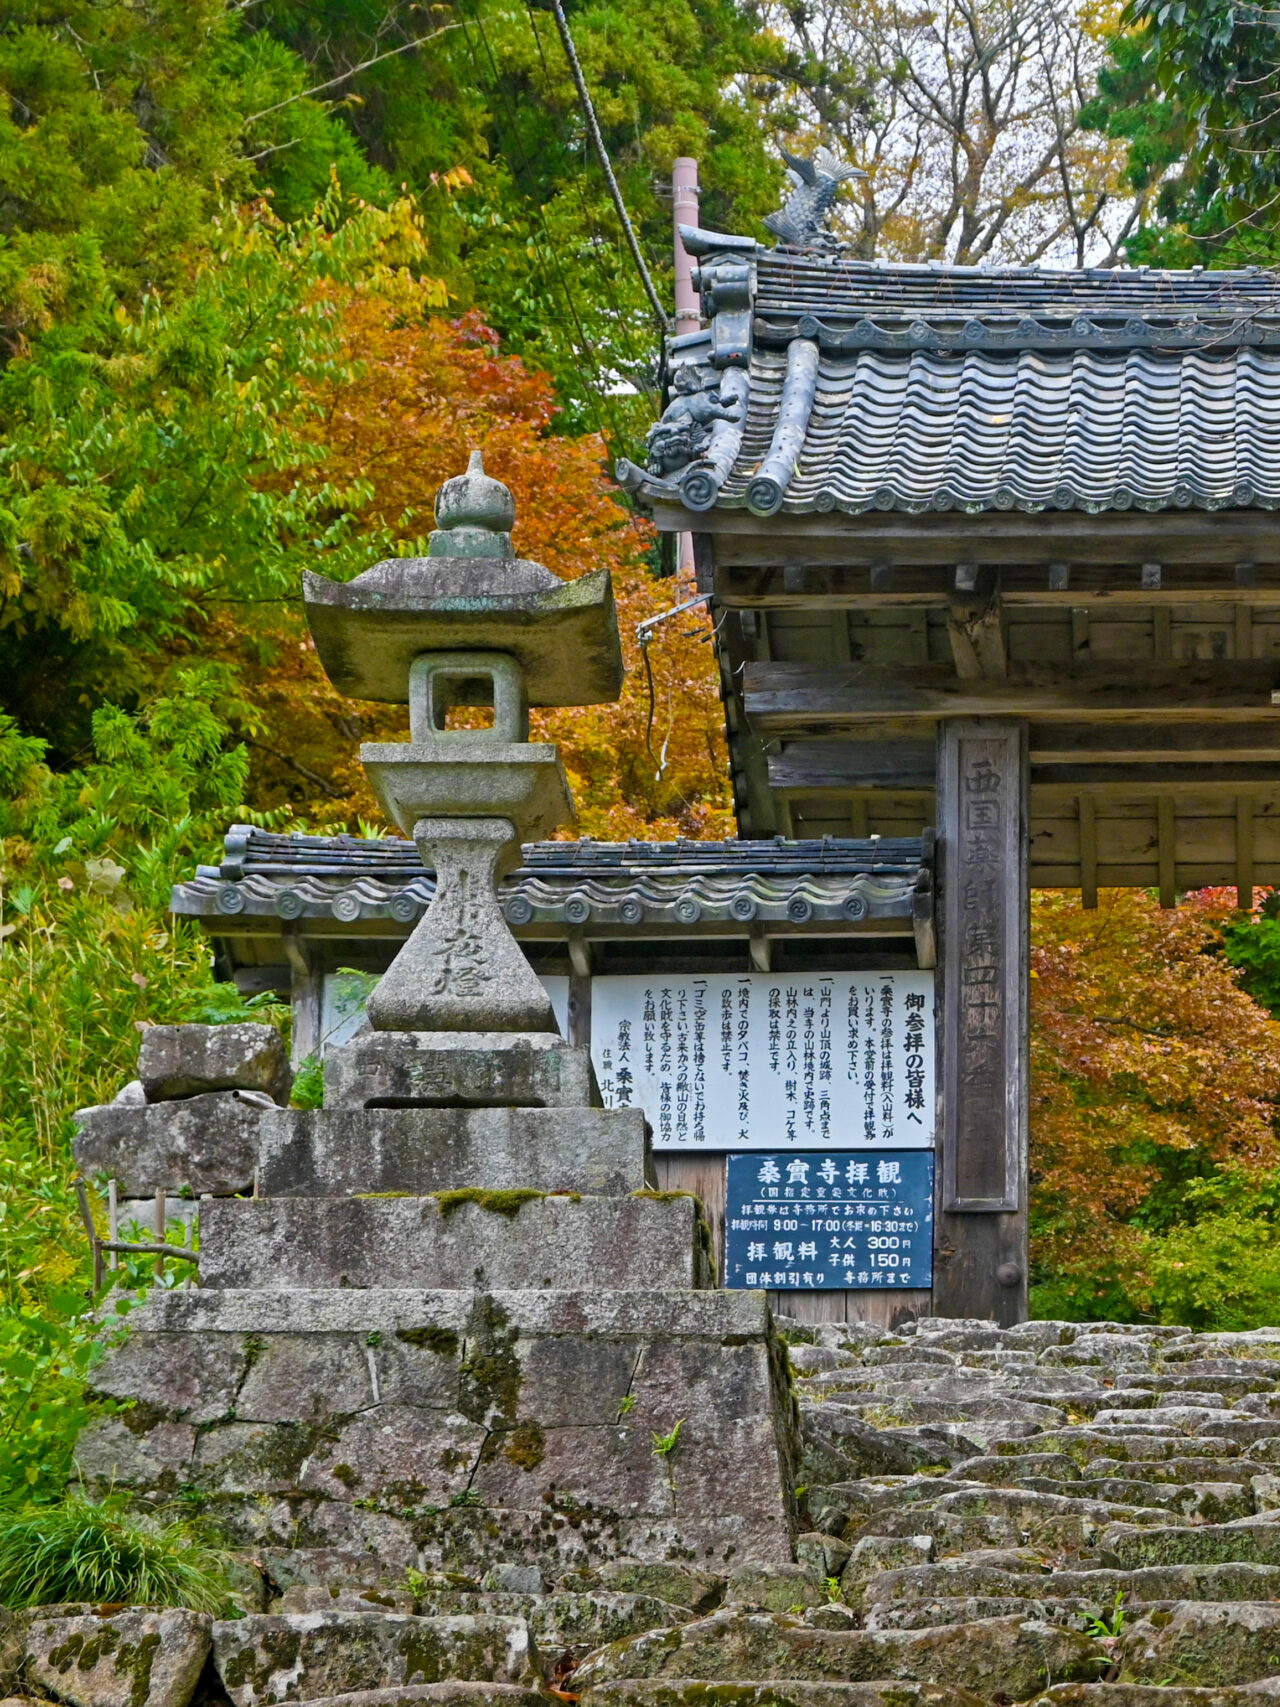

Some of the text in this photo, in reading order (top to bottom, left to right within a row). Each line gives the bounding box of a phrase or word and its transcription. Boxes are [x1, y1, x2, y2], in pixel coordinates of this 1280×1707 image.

[617, 1019, 632, 1063] 宗教法人
[643, 989, 656, 1077] をお願い致します。
[768, 988, 781, 1076] の採取は禁止です。
[903, 993, 925, 1125] 御参拝の皆様へ
[757, 1158, 903, 1185] 桑實寺拝観
[731, 1219, 768, 1232] 拝観時間
[747, 1241, 819, 1262] 拝観料
[830, 1236, 911, 1250] 大人 300円
[828, 1253, 911, 1268] 子供 150円
[745, 1271, 911, 1286] 団体割引有り 寺務所まで
